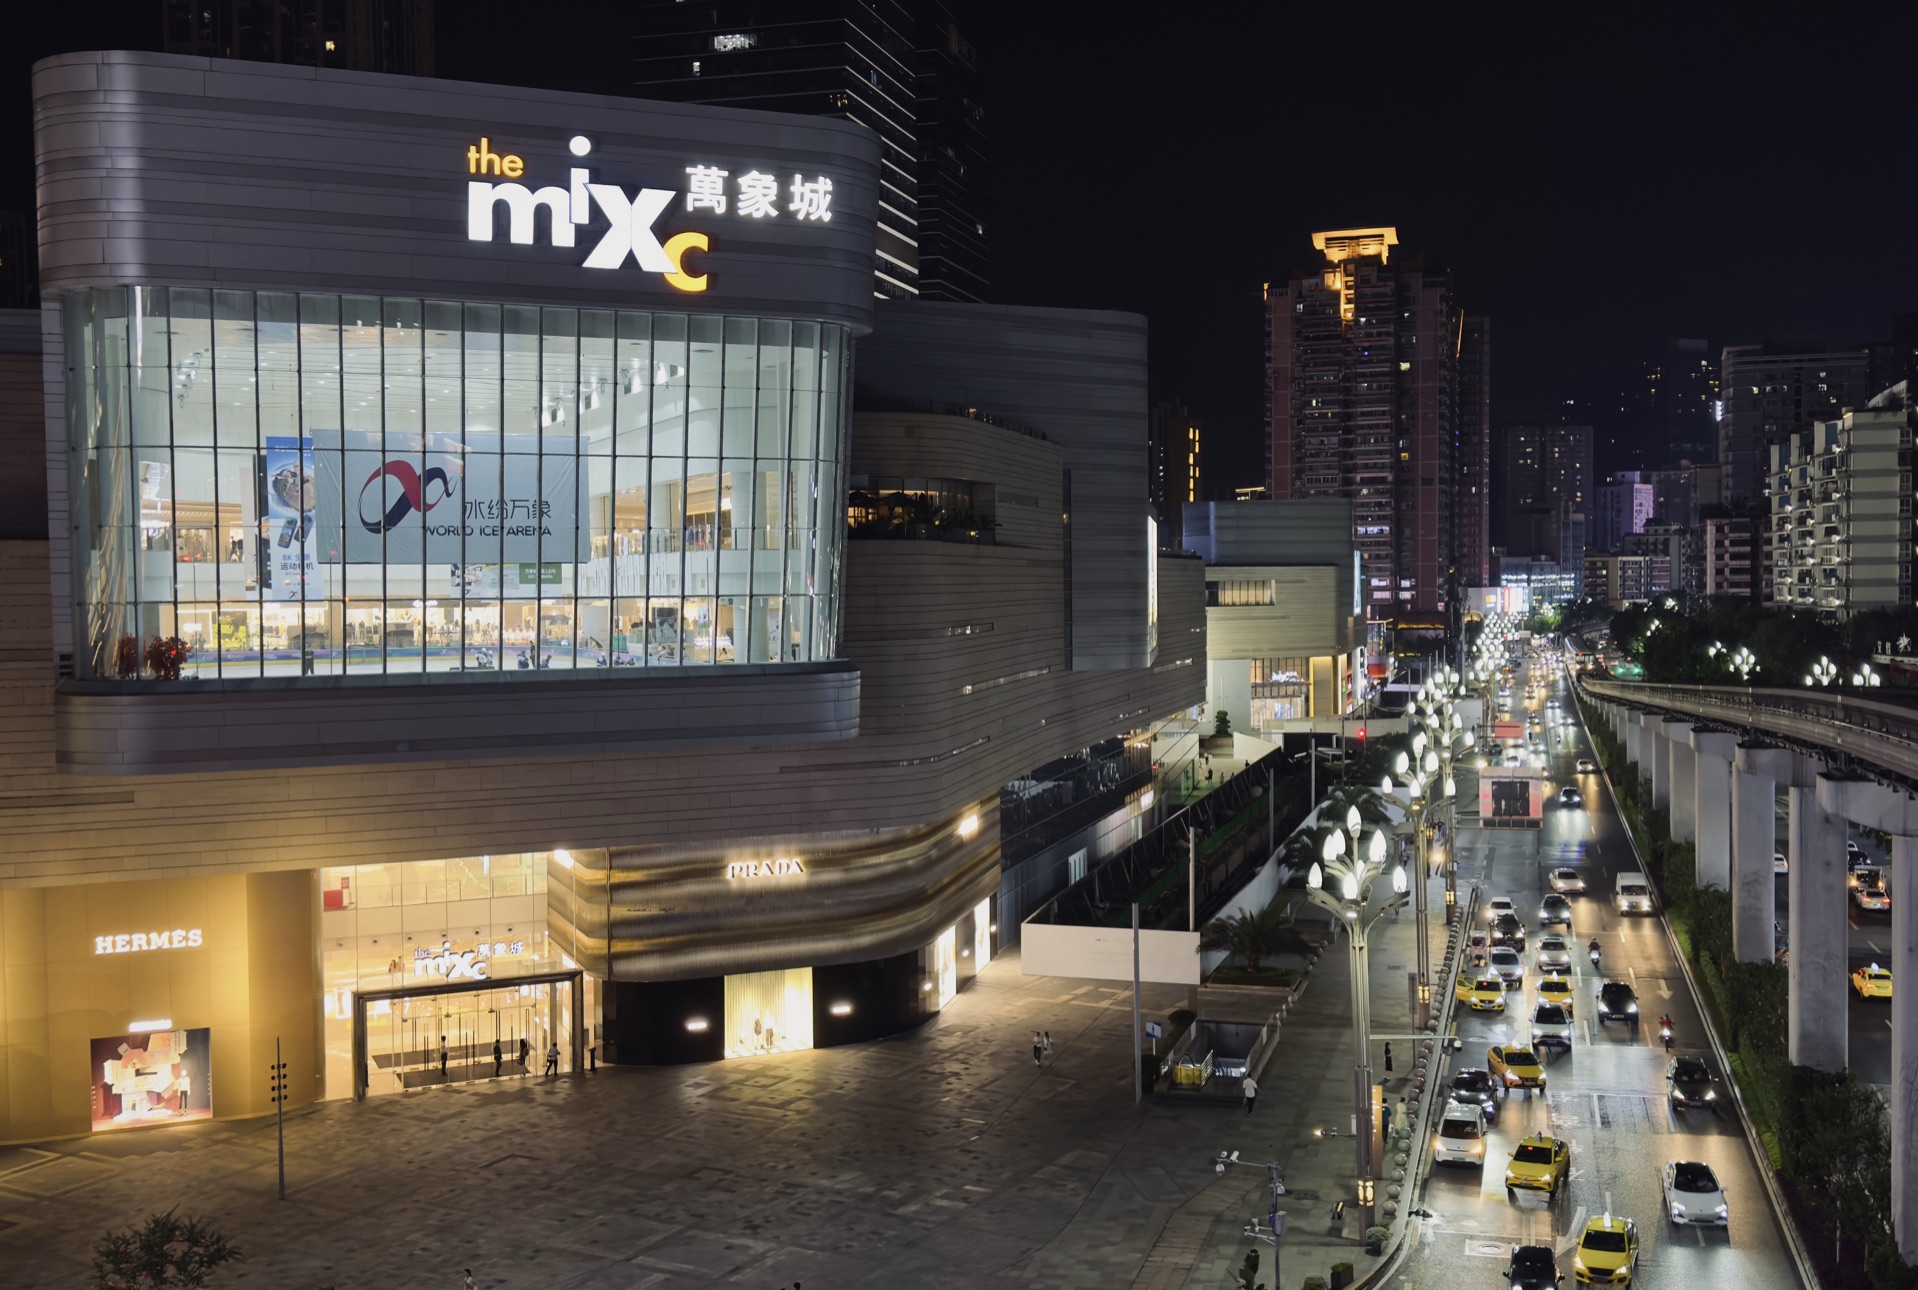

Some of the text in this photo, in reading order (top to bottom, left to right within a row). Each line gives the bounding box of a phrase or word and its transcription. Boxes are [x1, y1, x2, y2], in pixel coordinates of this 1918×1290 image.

[468, 137, 524, 177] the
[686, 164, 834, 222] 萬象城
[425, 525, 474, 536] WORLD
[479, 525, 499, 536] ICE
[727, 859, 804, 878] PRADA
[414, 946, 431, 958] the
[477, 940, 524, 958] 萬象城
